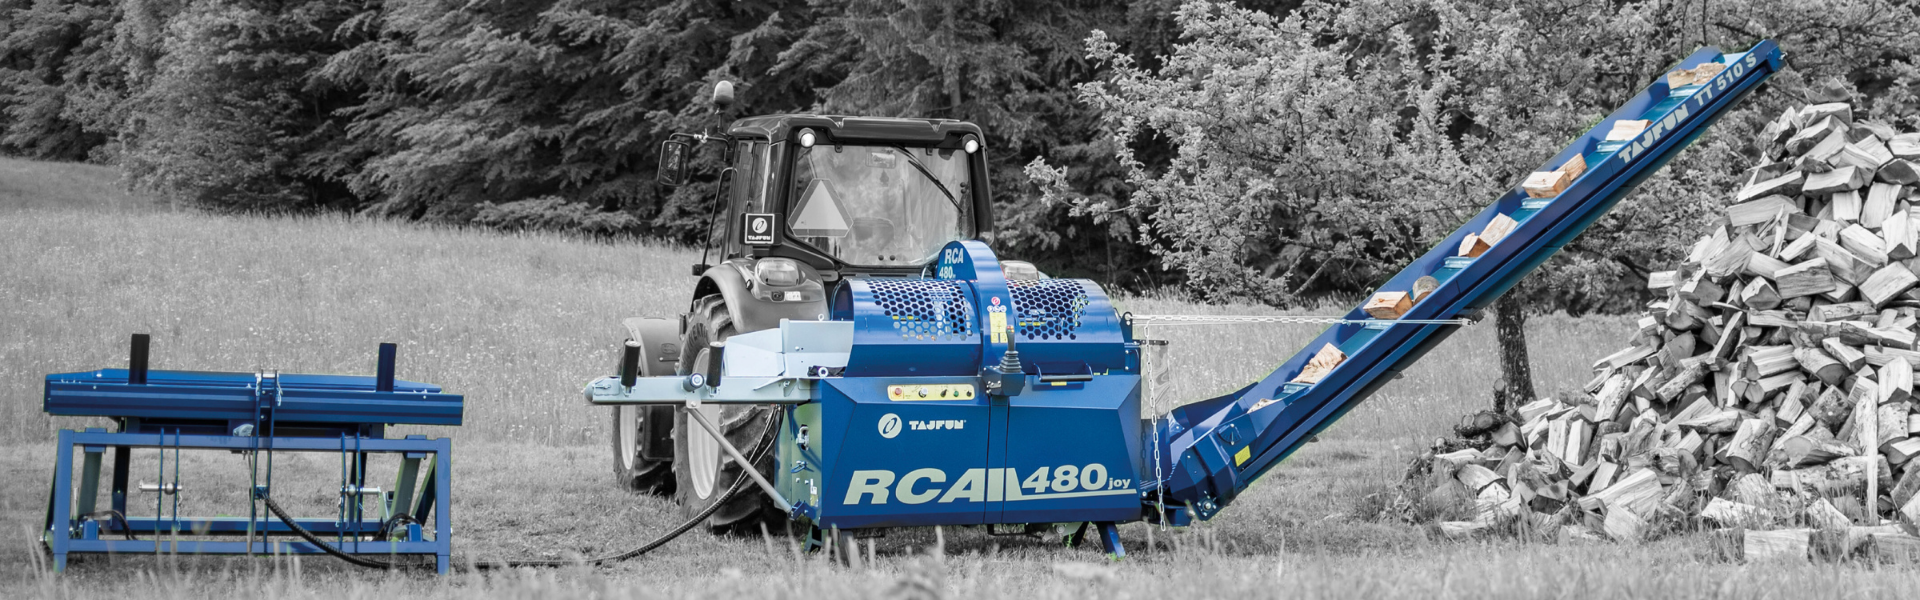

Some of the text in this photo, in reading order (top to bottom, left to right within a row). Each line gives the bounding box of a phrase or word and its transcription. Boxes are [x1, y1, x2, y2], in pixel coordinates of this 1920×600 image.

[1618, 52, 1757, 163] TAJFUN TT 510 S
[944, 247, 964, 264] RCA
[938, 265, 953, 279] 480
[1022, 463, 1108, 493] 480
[1108, 477, 1131, 490] joy
